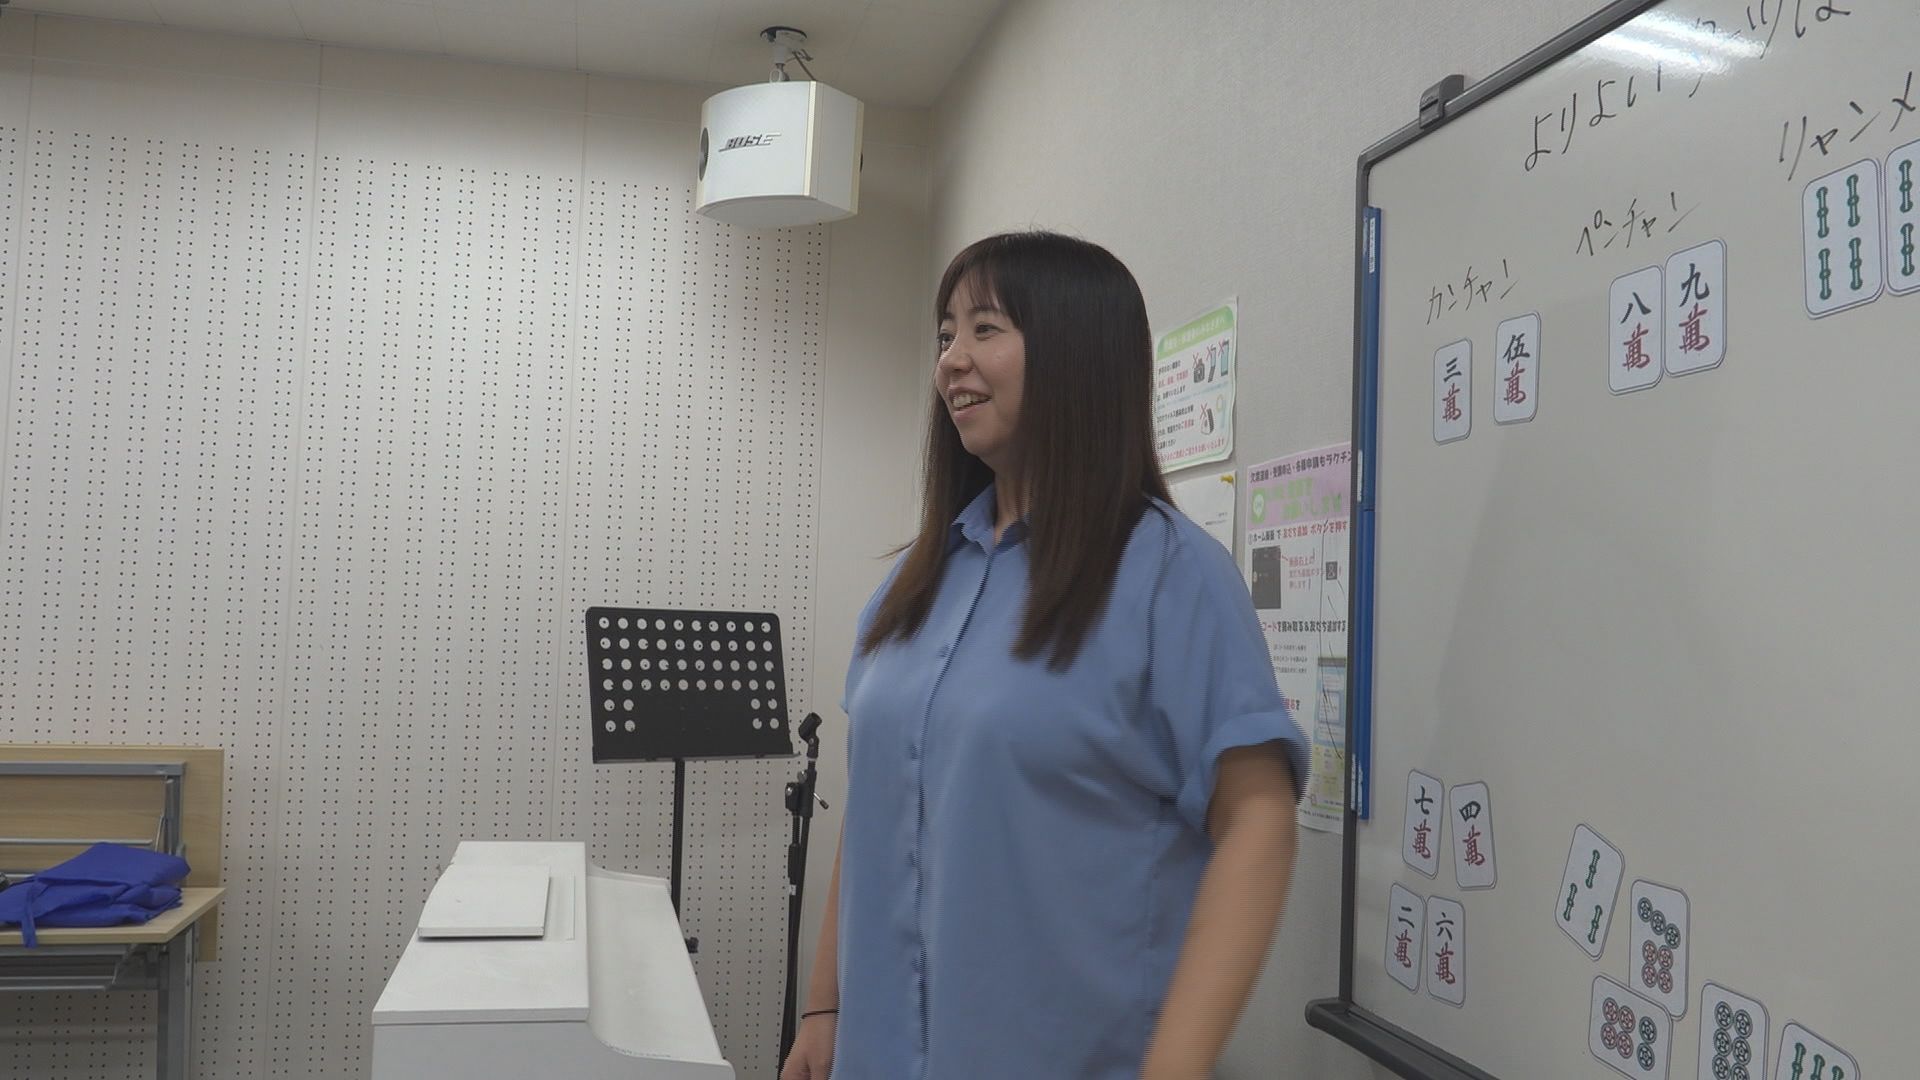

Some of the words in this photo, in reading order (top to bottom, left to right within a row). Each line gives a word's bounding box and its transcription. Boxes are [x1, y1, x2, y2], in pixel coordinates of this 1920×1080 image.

[1426, 258, 1519, 325] カンチャン
